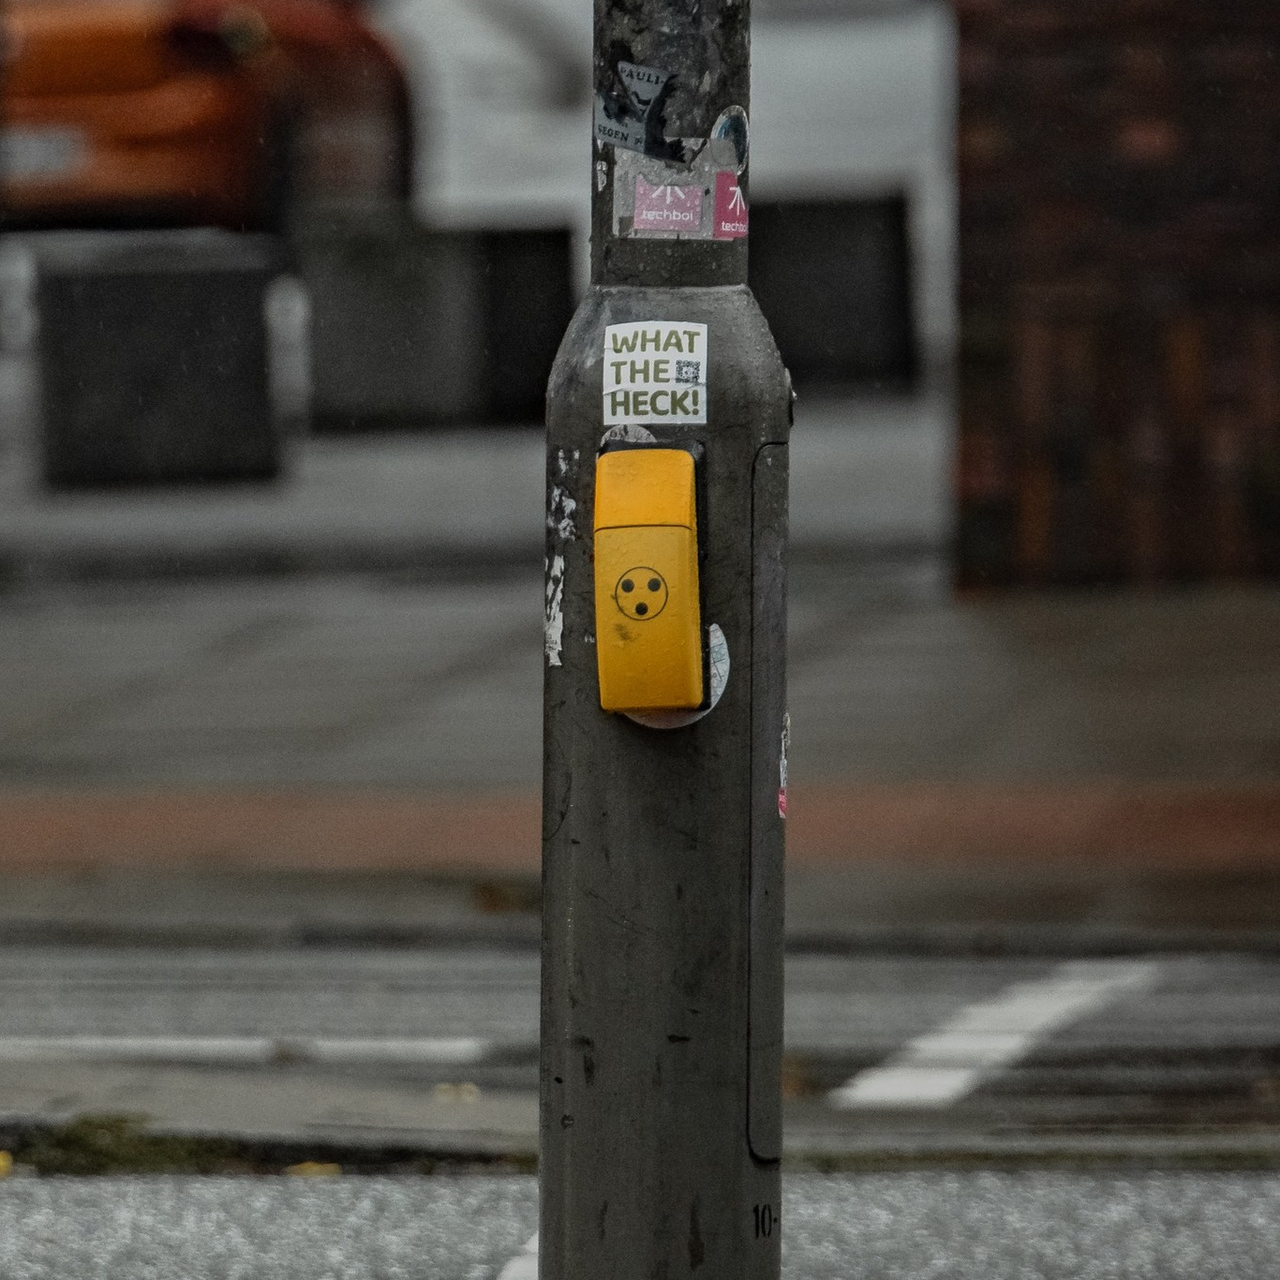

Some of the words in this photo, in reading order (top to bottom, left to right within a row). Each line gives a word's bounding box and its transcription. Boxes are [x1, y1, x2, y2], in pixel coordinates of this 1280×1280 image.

[642, 209, 693, 221] techboi
[612, 329, 700, 353] WHAT
[610, 359, 670, 385] THE
[611, 390, 699, 416] HECK!
